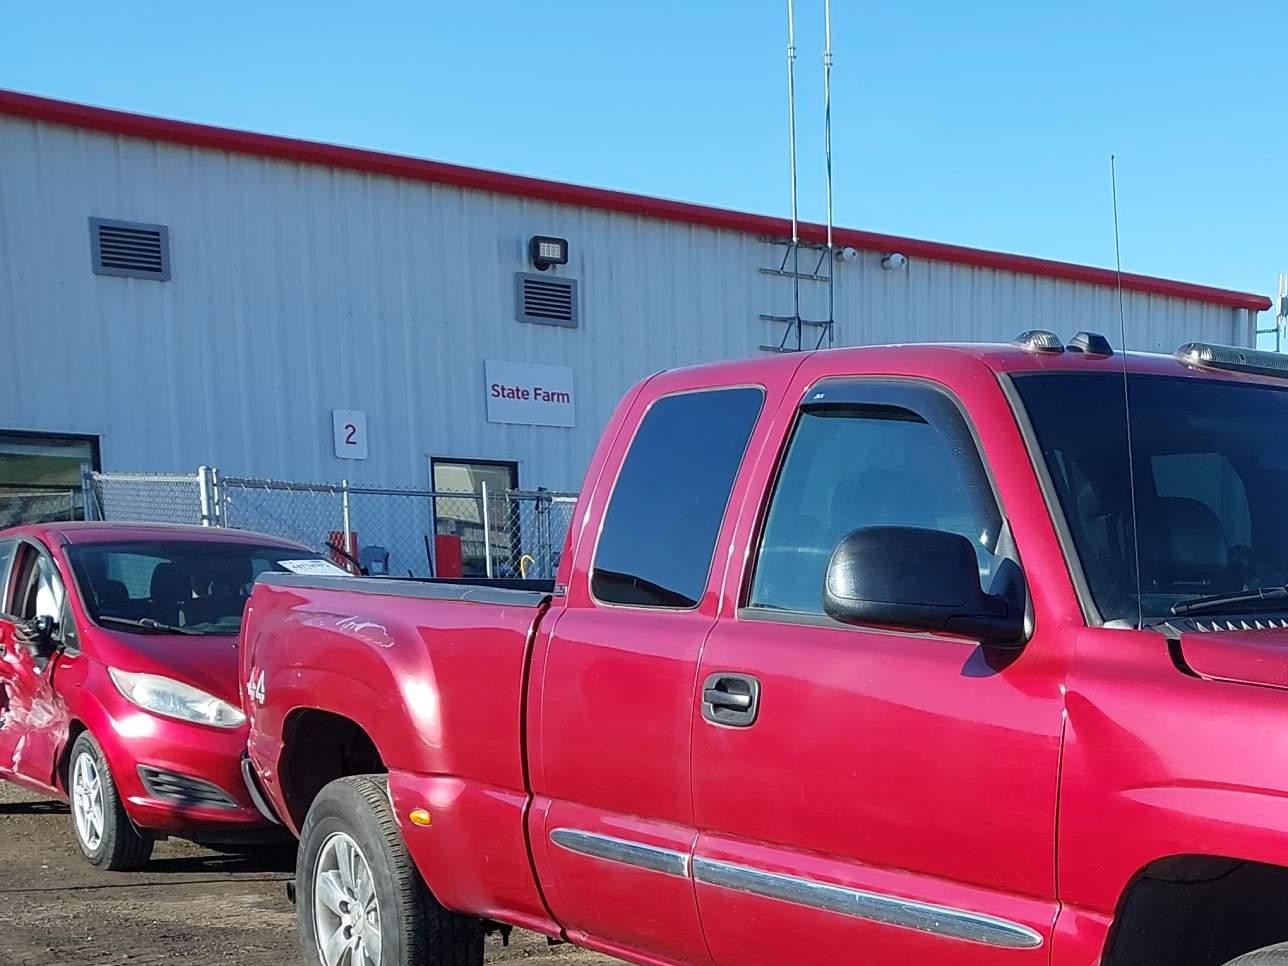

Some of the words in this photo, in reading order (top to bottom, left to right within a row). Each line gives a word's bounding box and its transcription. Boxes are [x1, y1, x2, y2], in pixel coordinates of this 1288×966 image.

[491, 383, 530, 401] State
[533, 387, 570, 404] Farm
[344, 423, 357, 445] 2
